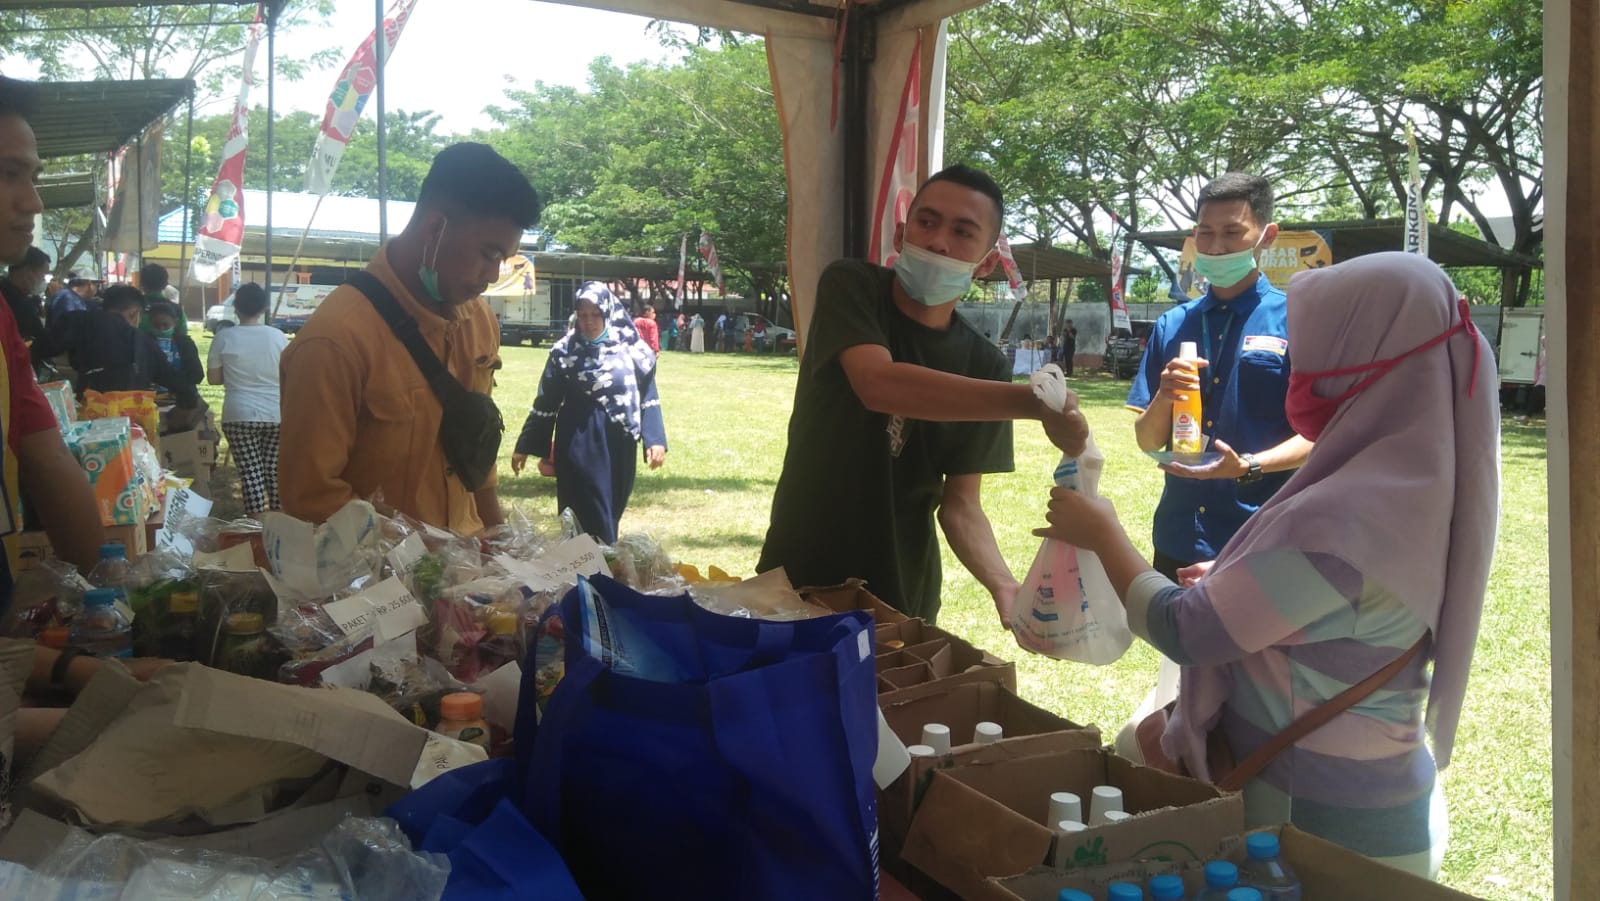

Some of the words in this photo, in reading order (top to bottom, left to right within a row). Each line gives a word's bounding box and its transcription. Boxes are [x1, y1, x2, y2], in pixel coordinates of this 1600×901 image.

[1408, 183, 1419, 254] ARKONA
[1261, 247, 1297, 257] ASAR
[1260, 255, 1299, 268] URAH
[342, 615, 368, 632] PAKET
